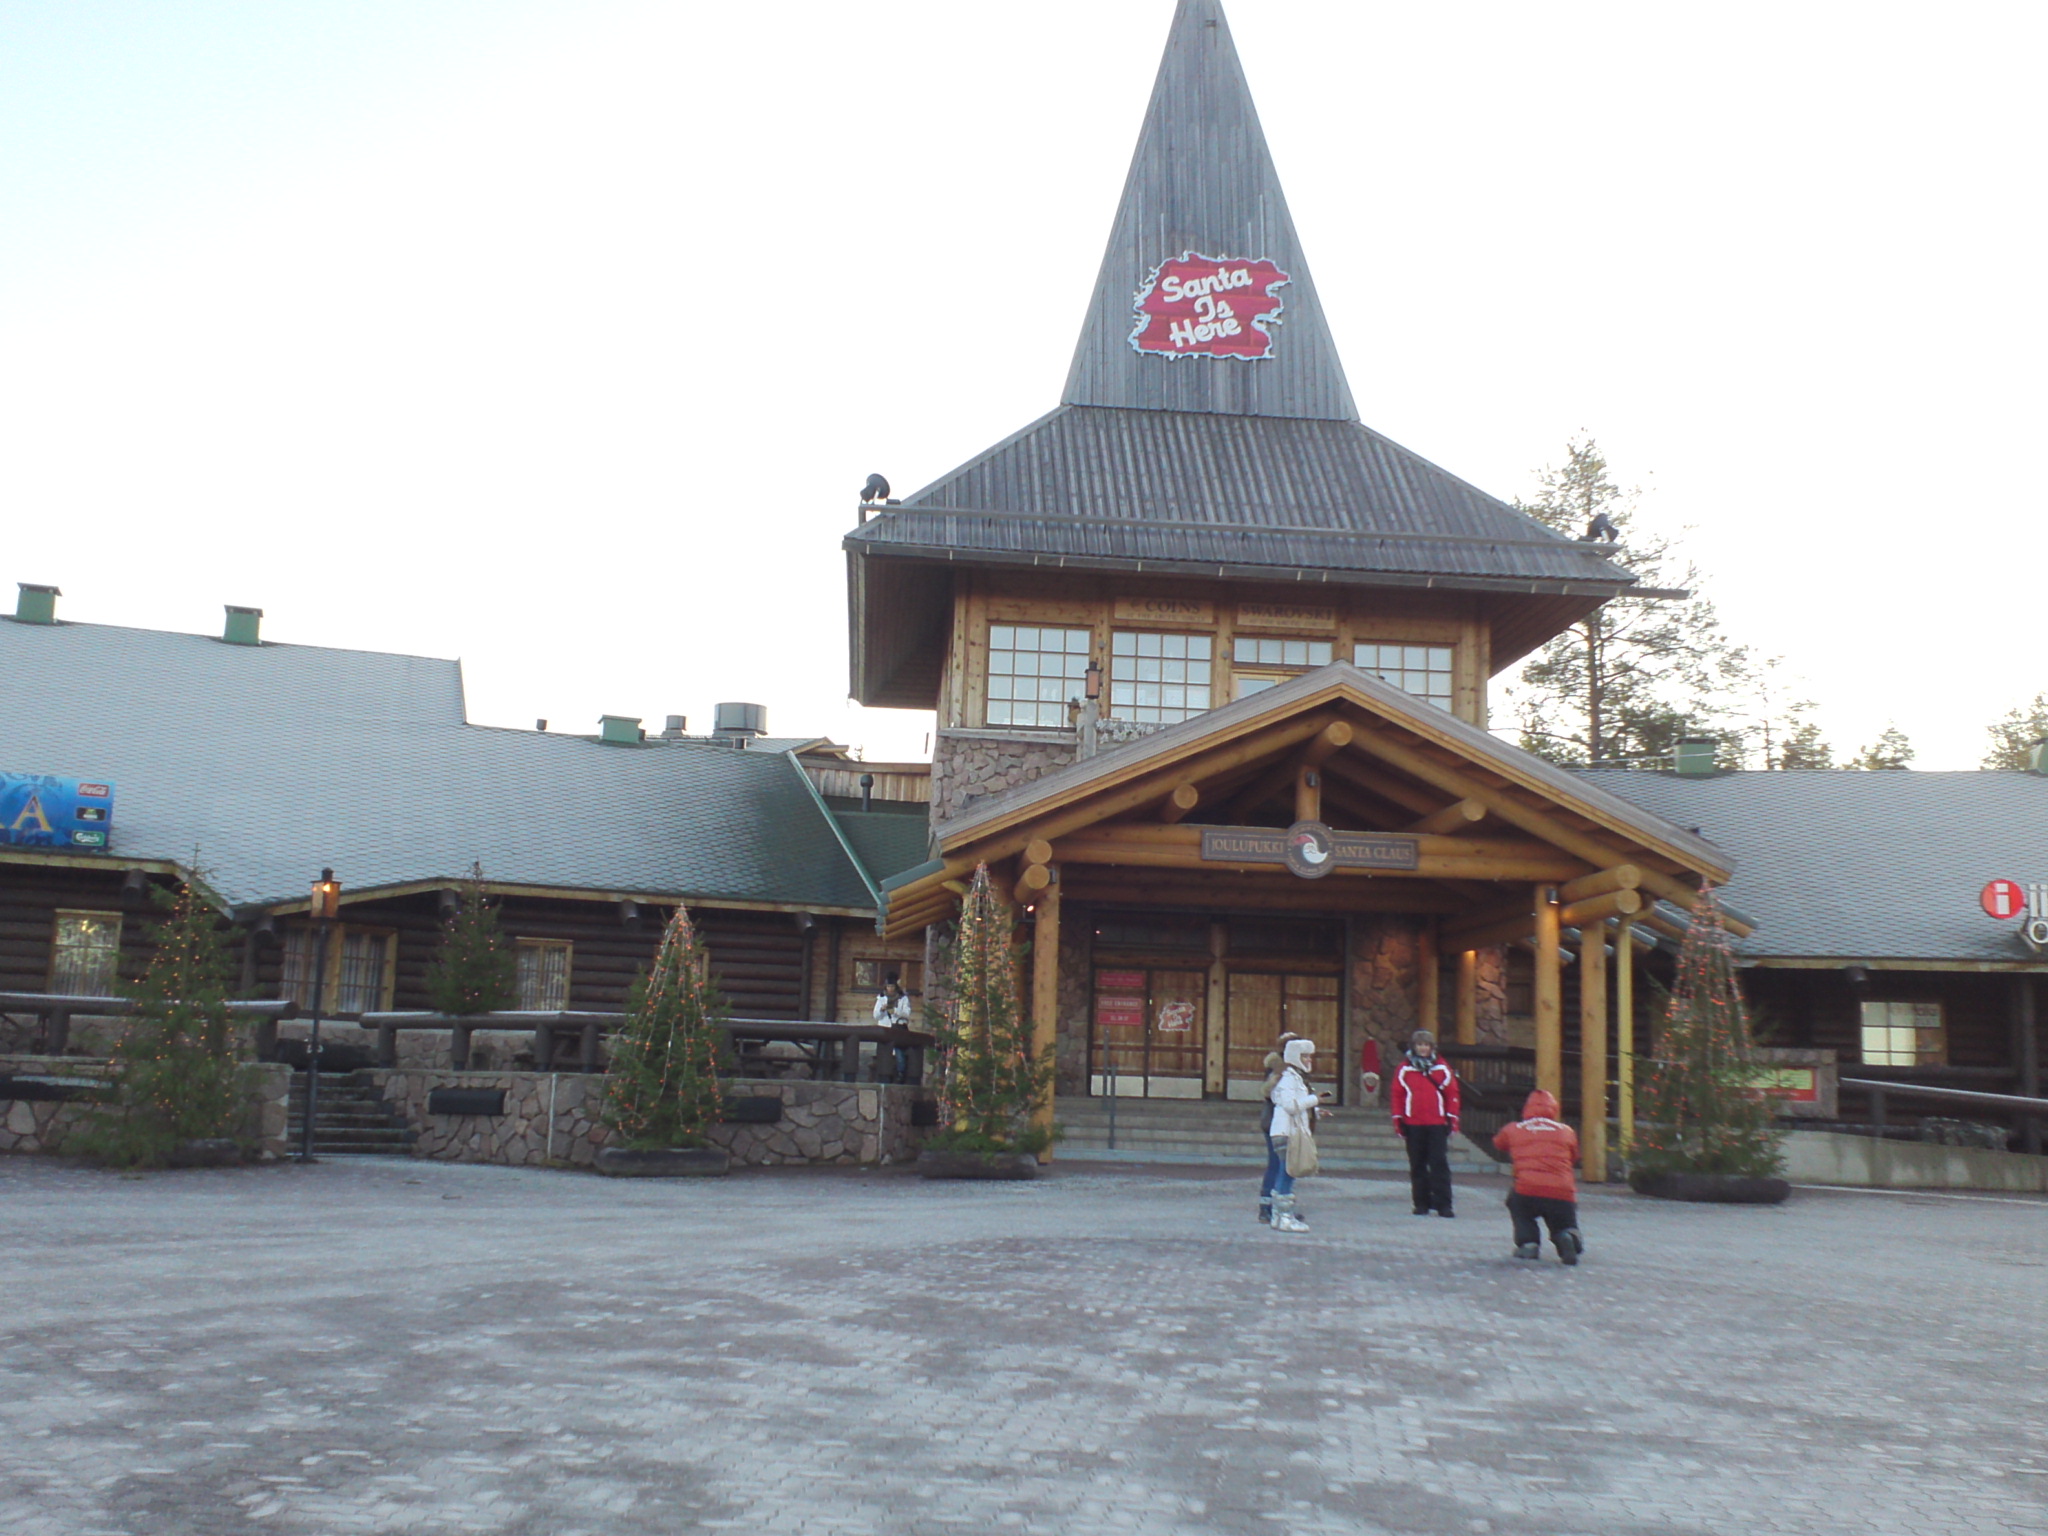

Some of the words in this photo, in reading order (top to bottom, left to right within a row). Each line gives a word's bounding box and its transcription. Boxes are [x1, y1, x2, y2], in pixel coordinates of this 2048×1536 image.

[1161, 267, 1253, 303] Santa
[1193, 294, 1235, 324] Is
[1169, 317, 1242, 348] Here
[1145, 599, 1201, 615] COINS
[1241, 604, 1332, 620] SWAROVSKI
[1211, 837, 1284, 854] JOULUPUKKI
[1334, 845, 1372, 859] SANTA
[1373, 846, 1411, 861] CLAUS
